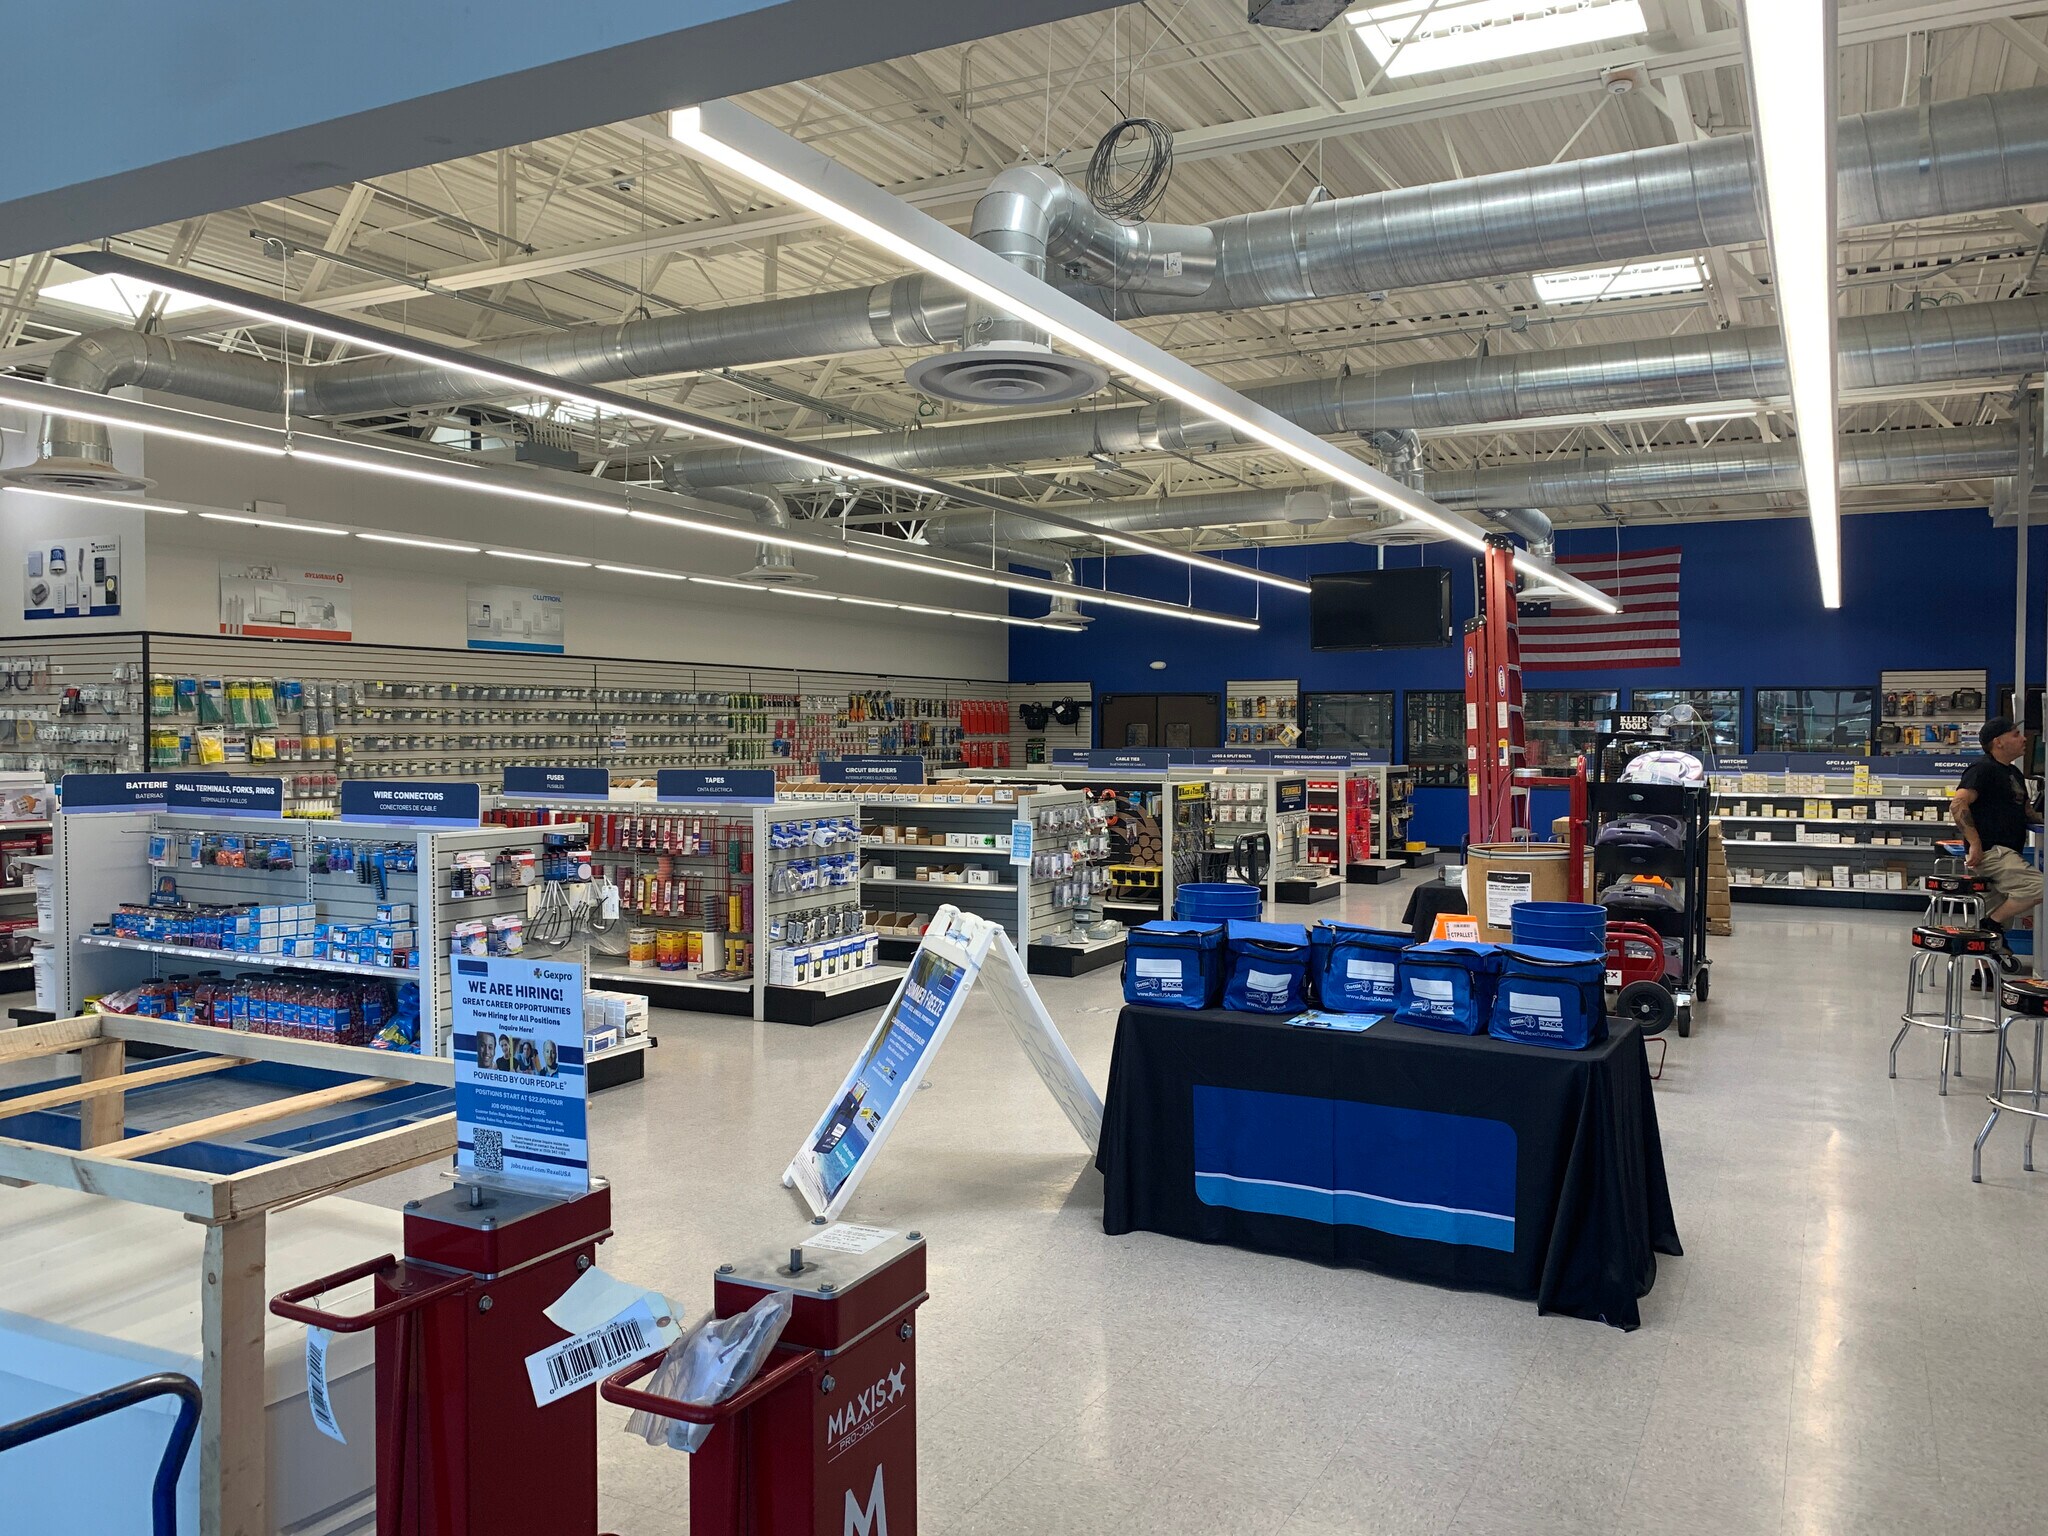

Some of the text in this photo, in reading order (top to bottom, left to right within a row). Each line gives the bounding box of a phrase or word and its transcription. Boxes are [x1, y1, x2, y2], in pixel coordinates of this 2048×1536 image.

[304, 572, 336, 581] SYLVANIA
[1620, 715, 1648, 723] KLEIN
[704, 776, 725, 784] TAPES
[174, 783, 275, 796] SMALL TERMINALS, FORKS, RINGS
[200, 796, 226, 804] TERMINALES
[373, 790, 444, 801] WIRE CONNECTORS
[379, 803, 413, 811] CONECTORES
[1450, 931, 1474, 939] CTPALLET
[1967, 941, 1985, 951] 3M
[543, 970, 573, 982] Gexpro
[468, 980, 564, 1001] WE ARE HIRING!
[1136, 991, 1182, 999] www.RexelUSA.com
[905, 979, 946, 1018] SUMMER FREEZE
[1271, 993, 1289, 1001] RACO
[1345, 993, 1393, 1003] www.RexelUSA.com
[462, 997, 571, 1016] GREAT CAREER OPPORTUNITIES
[472, 1009, 561, 1026] Now Hiring for All Positions
[498, 1023, 534, 1034] Inquire Here!
[1539, 1020, 1564, 1028] RACO
[473, 1071, 508, 1083] POWERED
[509, 1074, 519, 1083] BY
[519, 1076, 535, 1086] OUR
[475, 1088, 502, 1098] POSITIONS
[502, 1091, 520, 1100] START
[528, 1095, 564, 1106] $22.00/HOUR
[500, 1104, 524, 1112] OPENINGS
[524, 1107, 547, 1116] INCLUDE:
[523, 1121, 536, 1129] Project
[562, 1337, 583, 1350] MAXIS
[586, 1329, 602, 1339] PRO
[605, 1321, 618, 1330] JAX
[567, 1371, 594, 1387] 32886
[606, 1353, 632, 1368] 89540
[827, 1378, 887, 1445] MAXIS
[839, 1419, 876, 1451] PRO-JAX
[843, 1462, 888, 1536] M
